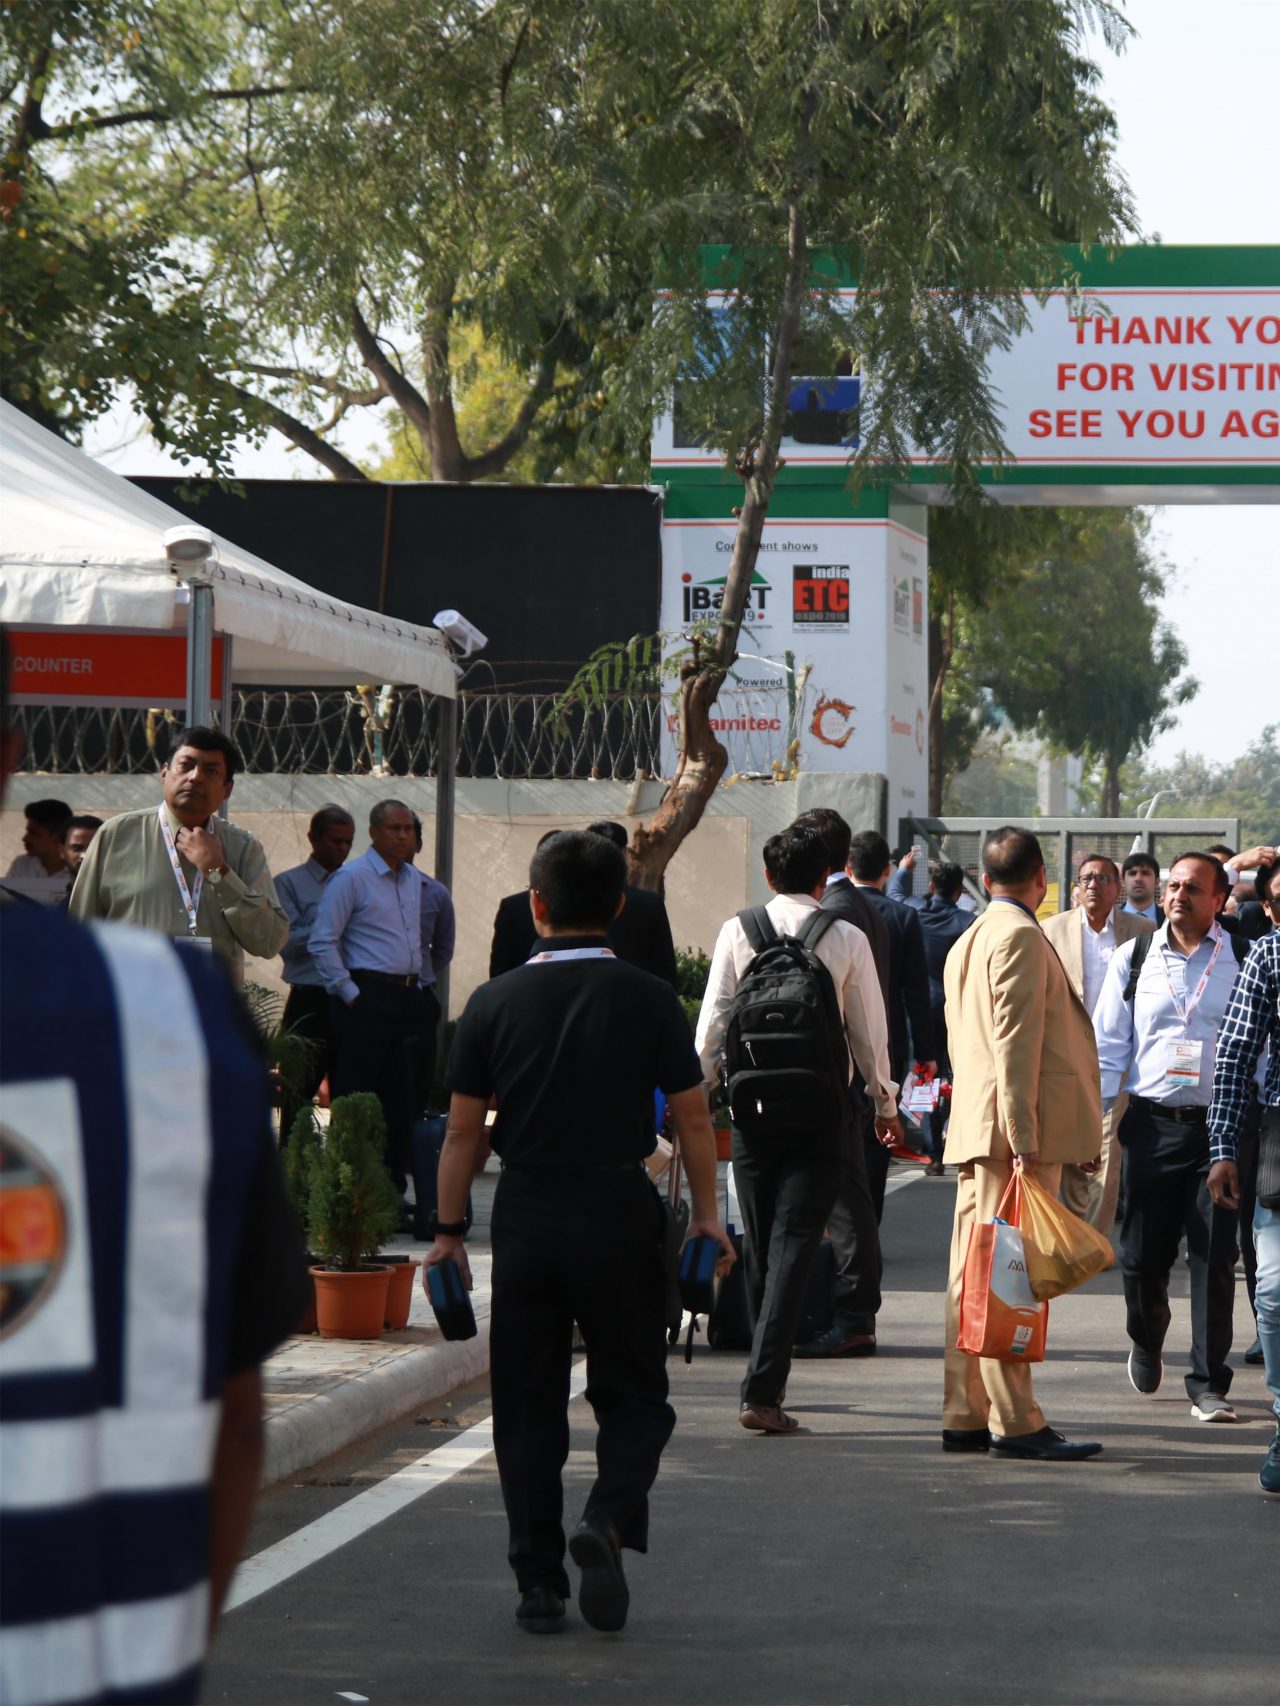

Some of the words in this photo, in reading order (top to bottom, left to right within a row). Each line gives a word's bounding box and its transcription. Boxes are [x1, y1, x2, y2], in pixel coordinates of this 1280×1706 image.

[1068, 316, 1212, 344] THANK
[1057, 363, 1135, 391] FOR
[1028, 409, 1102, 438] SEE
[1116, 409, 1205, 438] YOU
[782, 540, 818, 551] shows
[812, 566, 849, 579] india
[794, 579, 849, 612] ETC
[14, 656, 92, 673] COUNTER
[737, 677, 782, 686] Powered
